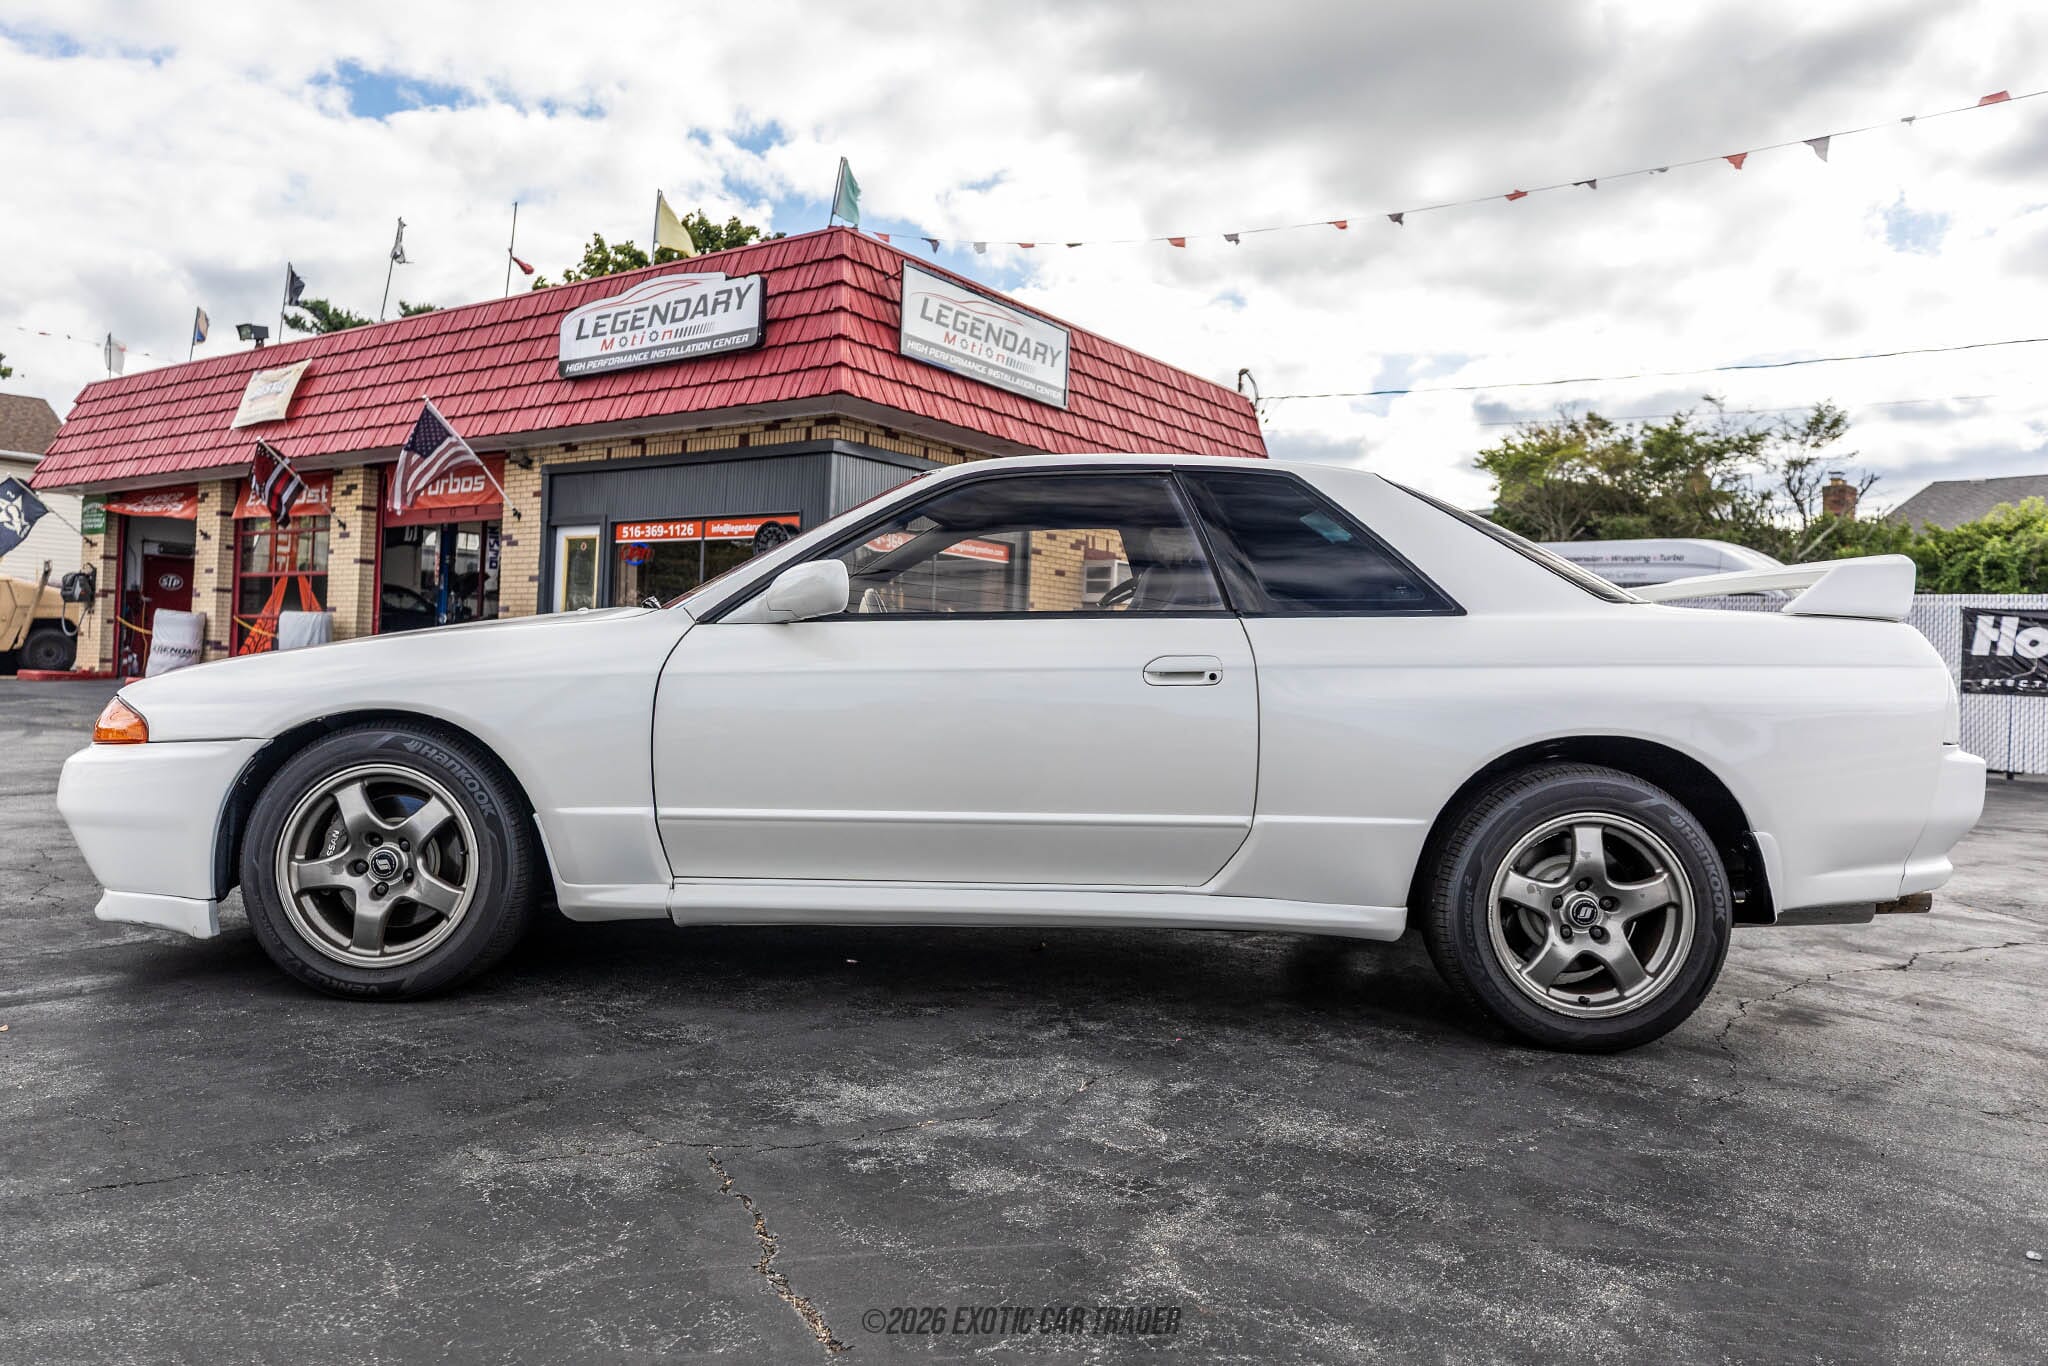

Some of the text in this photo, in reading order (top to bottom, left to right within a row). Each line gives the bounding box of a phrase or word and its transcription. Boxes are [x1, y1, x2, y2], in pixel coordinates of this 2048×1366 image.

[575, 282, 754, 341] LEGENDARY
[600, 329, 673, 351] Motion
[920, 297, 1063, 368] LEGENDARY
[943, 331, 1006, 364] Motion
[565, 334, 749, 374] HIGH PERFORMANCE INSTALLATION CENTER
[907, 340, 1063, 399] HIGH PERFORMANCE INSTALLATION CENTER
[420, 472, 486, 497] urbos
[622, 523, 694, 538] 516-369-1126
[326, 829, 340, 857] SSAN
